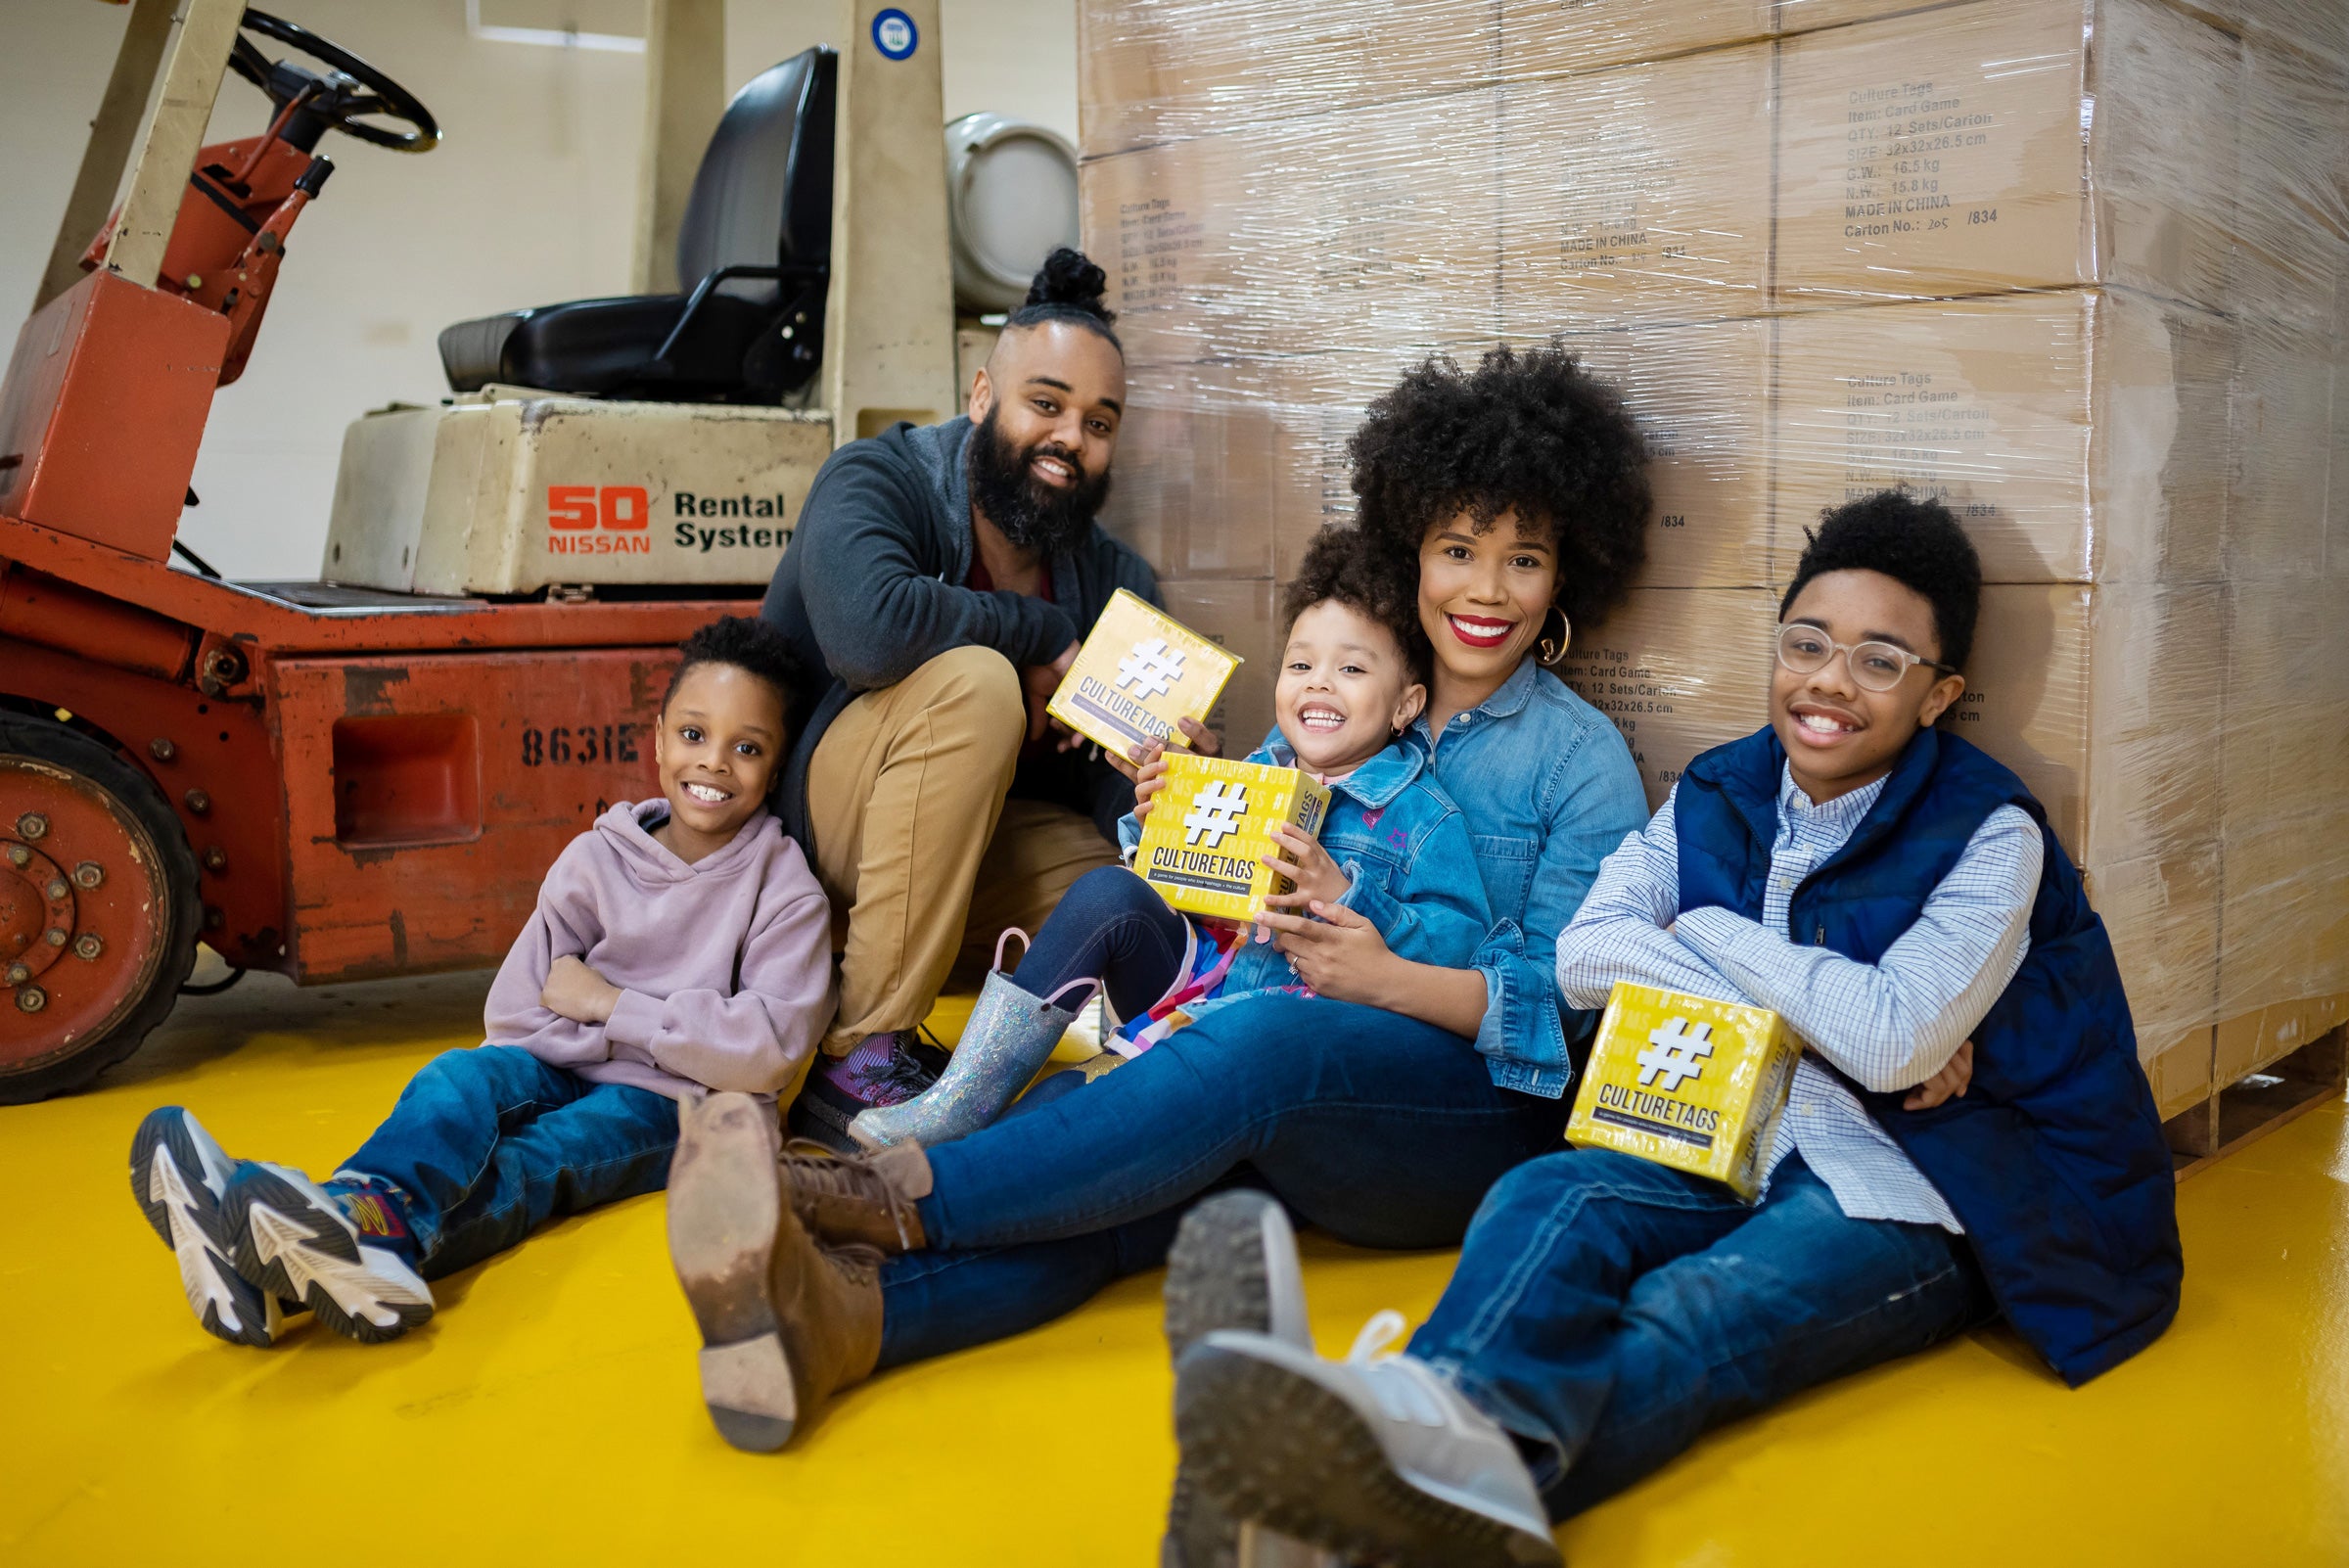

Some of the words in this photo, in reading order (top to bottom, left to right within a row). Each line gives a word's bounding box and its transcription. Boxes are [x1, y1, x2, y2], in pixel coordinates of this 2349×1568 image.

[1849, 88, 1900, 104] Culture
[1903, 81, 1933, 96] Tags
[1848, 110, 1881, 123] Item:
[1885, 104, 1916, 118] Card
[1920, 98, 1960, 113] Game
[1886, 123, 1902, 137] 12
[1886, 135, 1962, 157] 32x32x26.5
[1965, 133, 1987, 146] cm
[1893, 161, 1920, 175] 16.5
[1923, 158, 1940, 173] kg
[1891, 179, 1918, 195] 15.8
[1922, 177, 1939, 193] kg
[1845, 203, 1885, 219] MADE
[1888, 200, 1902, 214] IN
[1906, 195, 1951, 213] CHINA
[1844, 223, 1889, 238] Carton
[1967, 208, 1998, 226] /834
[1560, 238, 1593, 253] MADE
[1595, 236, 1607, 249] IN
[1610, 232, 1647, 247] CHINA
[1900, 372, 1932, 388] Tags
[1883, 392, 1915, 406] Card
[1918, 390, 1958, 403] Game
[548, 485, 649, 530] 50
[674, 492, 784, 519] Rental
[1966, 503, 1997, 518] /834
[1661, 515, 1684, 528] /834
[548, 535, 650, 555] NISSAN
[1604, 649, 1629, 663] Tags
[1590, 666, 1616, 677] Card
[1619, 668, 1651, 678] Game
[1592, 682, 1604, 694] 12
[1609, 683, 1677, 697] Sets/Carton
[1079, 674, 1175, 741] CULTURETAGS
[1656, 705, 1673, 714] cm
[1622, 717, 1635, 732] kg
[1959, 712, 1980, 722] cm
[1152, 846, 1256, 880] CULTURETAGS
[1598, 1082, 1723, 1131] CULTURETAGS
